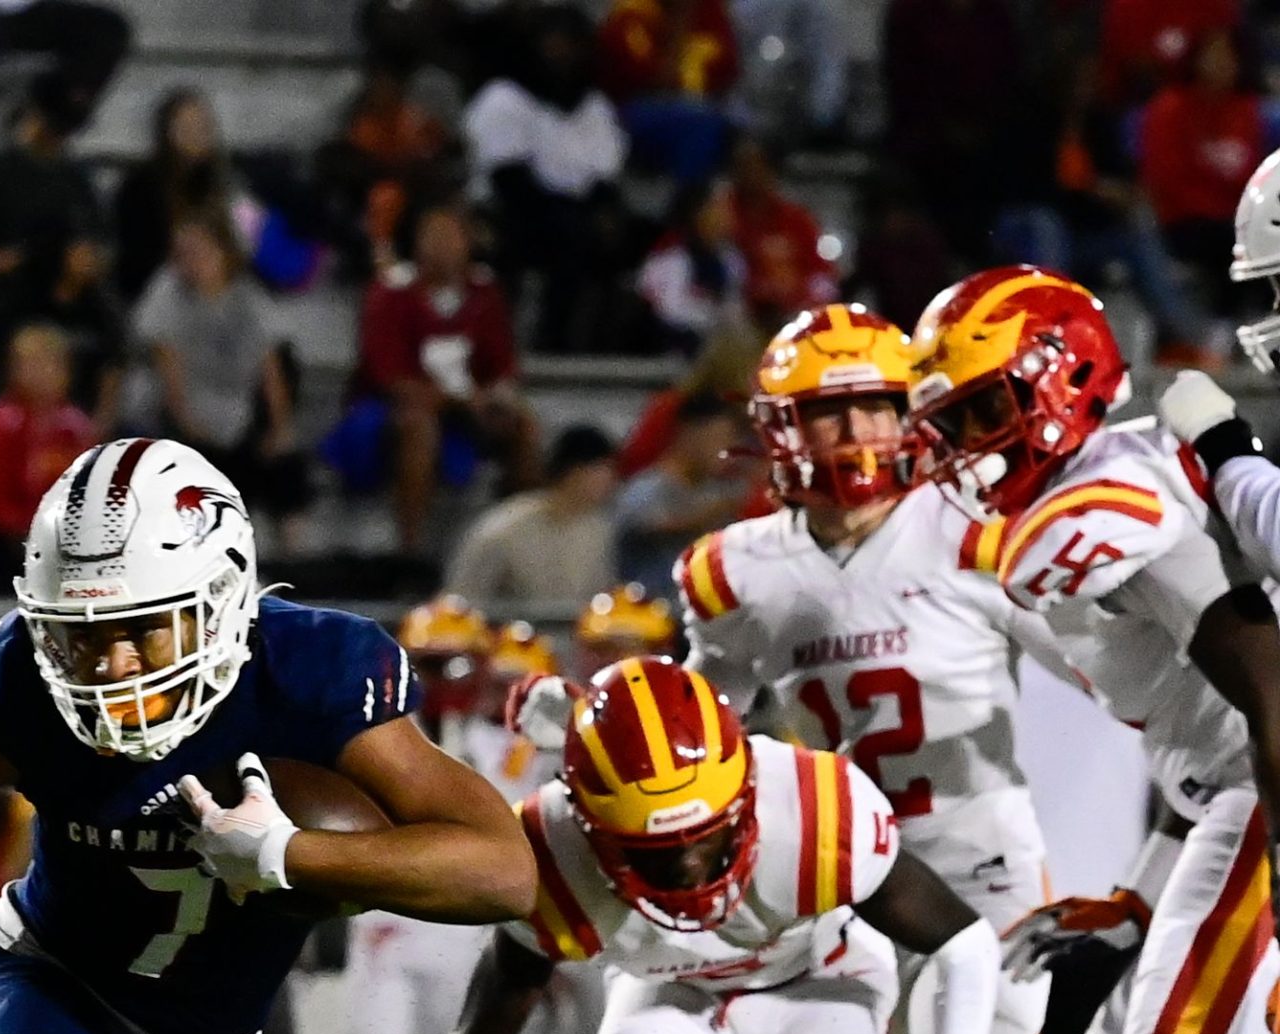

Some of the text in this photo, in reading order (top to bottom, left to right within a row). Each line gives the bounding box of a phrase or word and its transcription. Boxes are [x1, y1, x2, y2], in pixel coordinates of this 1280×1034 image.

[792, 625, 908, 668] MARAUDERS
[798, 668, 933, 819] 12
[67, 821, 195, 851] CHAMI
[128, 866, 215, 979] 7
